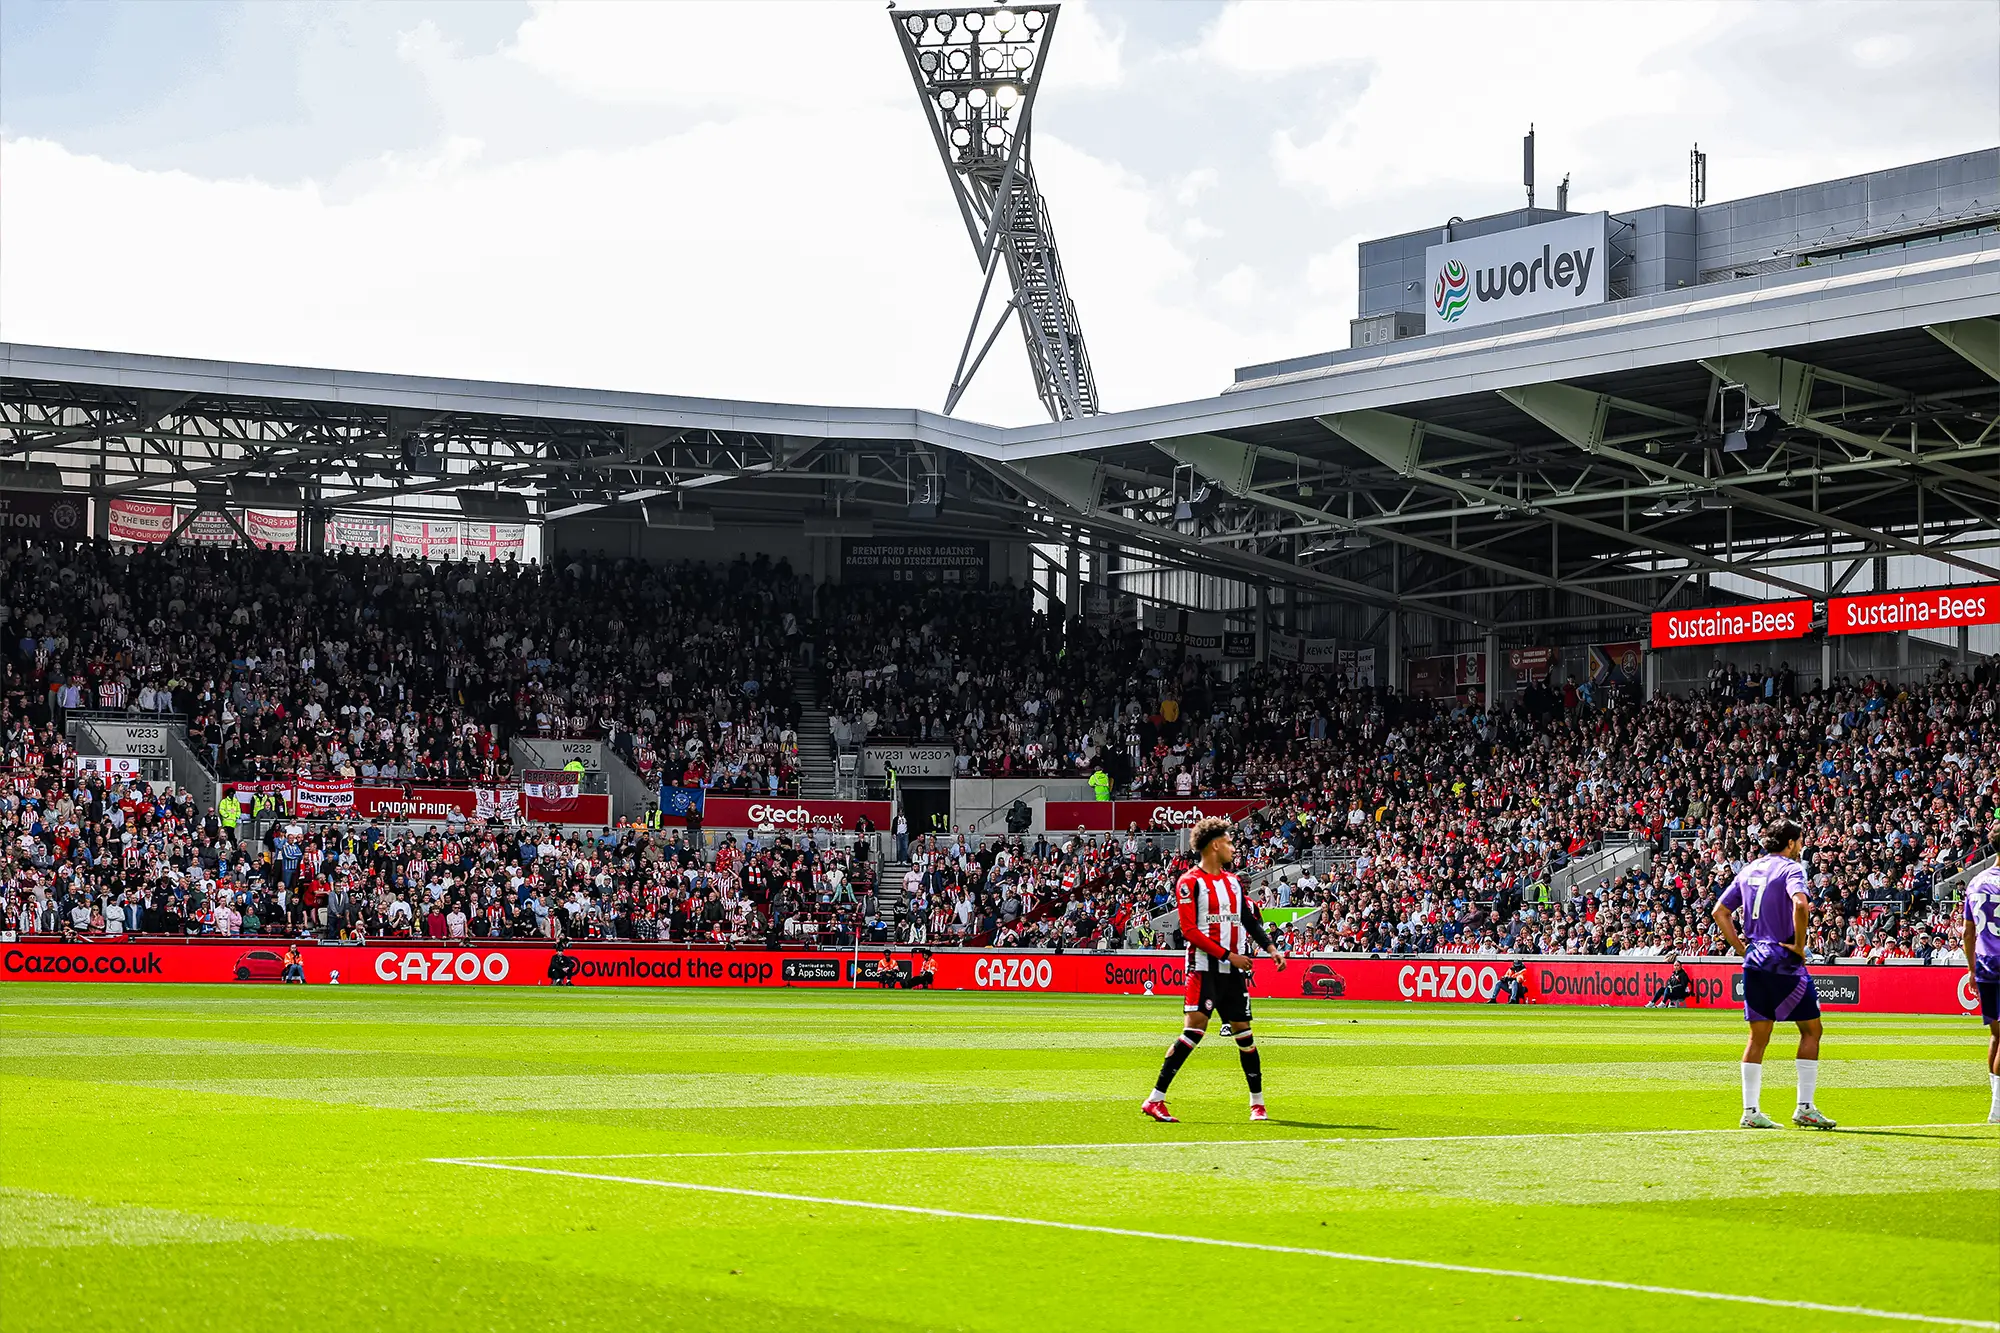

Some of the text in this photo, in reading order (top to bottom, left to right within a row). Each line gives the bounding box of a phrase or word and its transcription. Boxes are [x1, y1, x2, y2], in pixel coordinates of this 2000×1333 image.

[1475, 243, 1595, 302] worley
[125, 503, 156, 513] WOODY
[121, 515, 159, 526] THE BEES
[852, 546, 975, 555] BRENTFORD FANS AGAINST
[846, 556, 984, 566] RACISM AND DISCRIMINATION
[1847, 596, 1986, 627] Sustaina-Bees
[1668, 610, 1795, 639] Sustaina-Bees
[1148, 630, 1216, 647] LOUD & PROUD
[126, 728, 159, 738] W233
[126, 744, 156, 754] W133
[562, 744, 592, 753] W232
[874, 751, 903, 760] W231
[909, 751, 942, 760] W230
[562, 759, 589, 768] W2
[895, 765, 921, 774] W131
[527, 772, 577, 783] BRENTFORD
[237, 783, 270, 791] Brentrd
[300, 791, 353, 803] BRENTFORD
[370, 801, 417, 814] LONDON
[748, 804, 844, 824] Gtech.co.uk
[1747, 876, 1767, 920] 7
[4, 950, 162, 974] Cazoo.co.uk
[375, 951, 509, 981] CAZOO
[687, 957, 723, 979] the
[728, 961, 773, 983] app
[798, 968, 835, 978] App Store
[975, 958, 1052, 988] CAZOO
[1105, 962, 1156, 986] Search
[1398, 964, 1498, 998] CAZOO
[1541, 970, 1640, 996] Download
[1814, 986, 1856, 1001] Google Play
